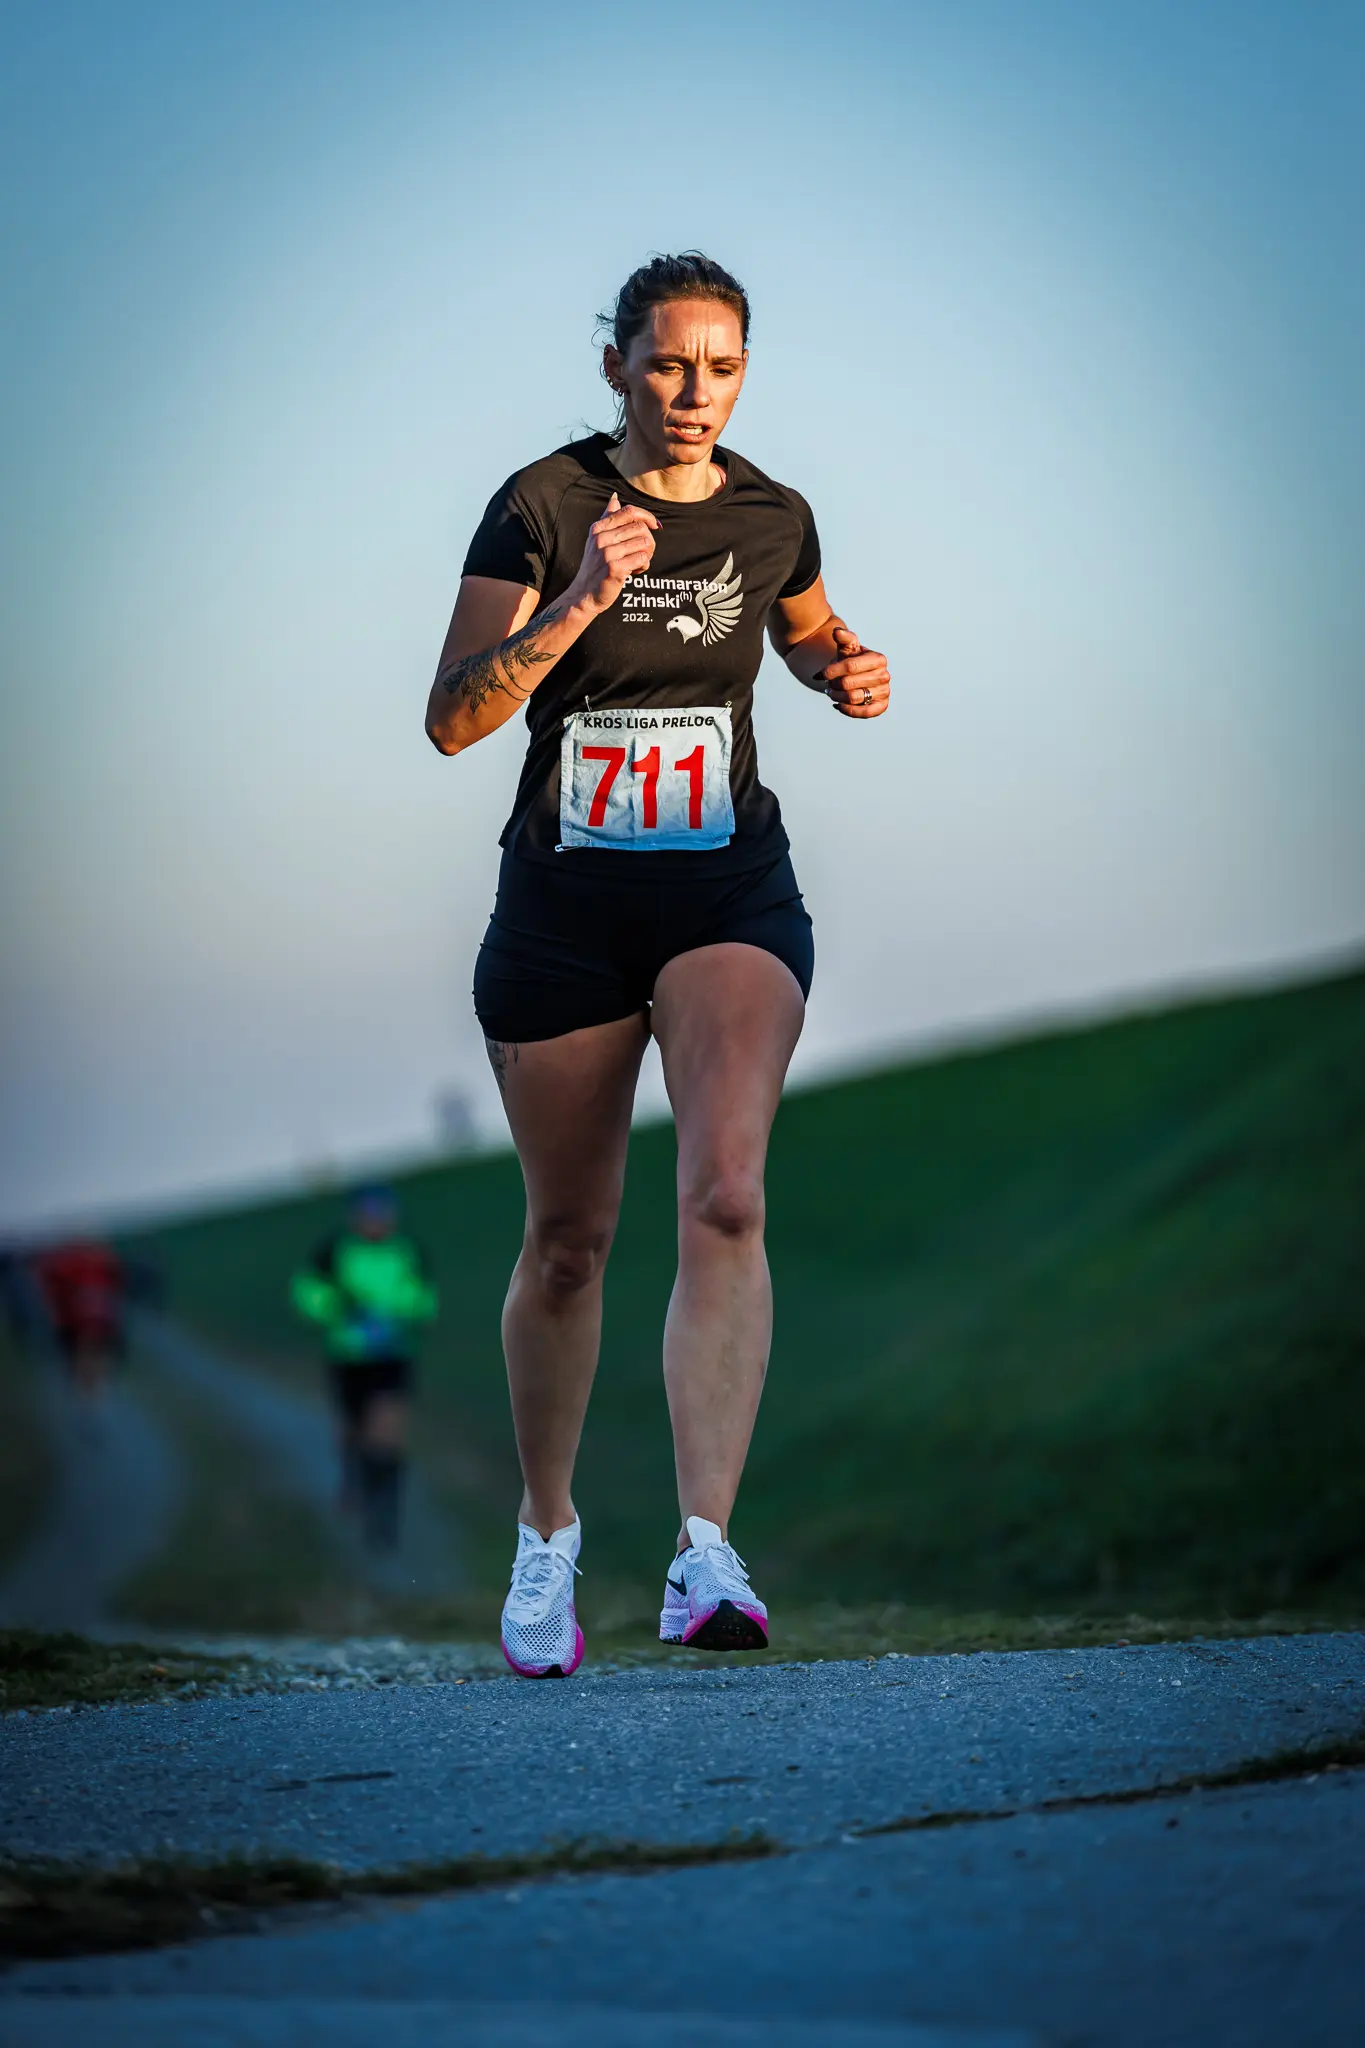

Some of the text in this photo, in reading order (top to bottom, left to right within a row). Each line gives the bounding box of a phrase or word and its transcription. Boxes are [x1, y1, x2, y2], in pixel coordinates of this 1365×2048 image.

[622, 575, 728, 593] Polumaraton
[622, 613, 653, 622] 2022.
[583, 716, 715, 729] KROS LIGA PRELOG
[582, 745, 704, 829] 711
